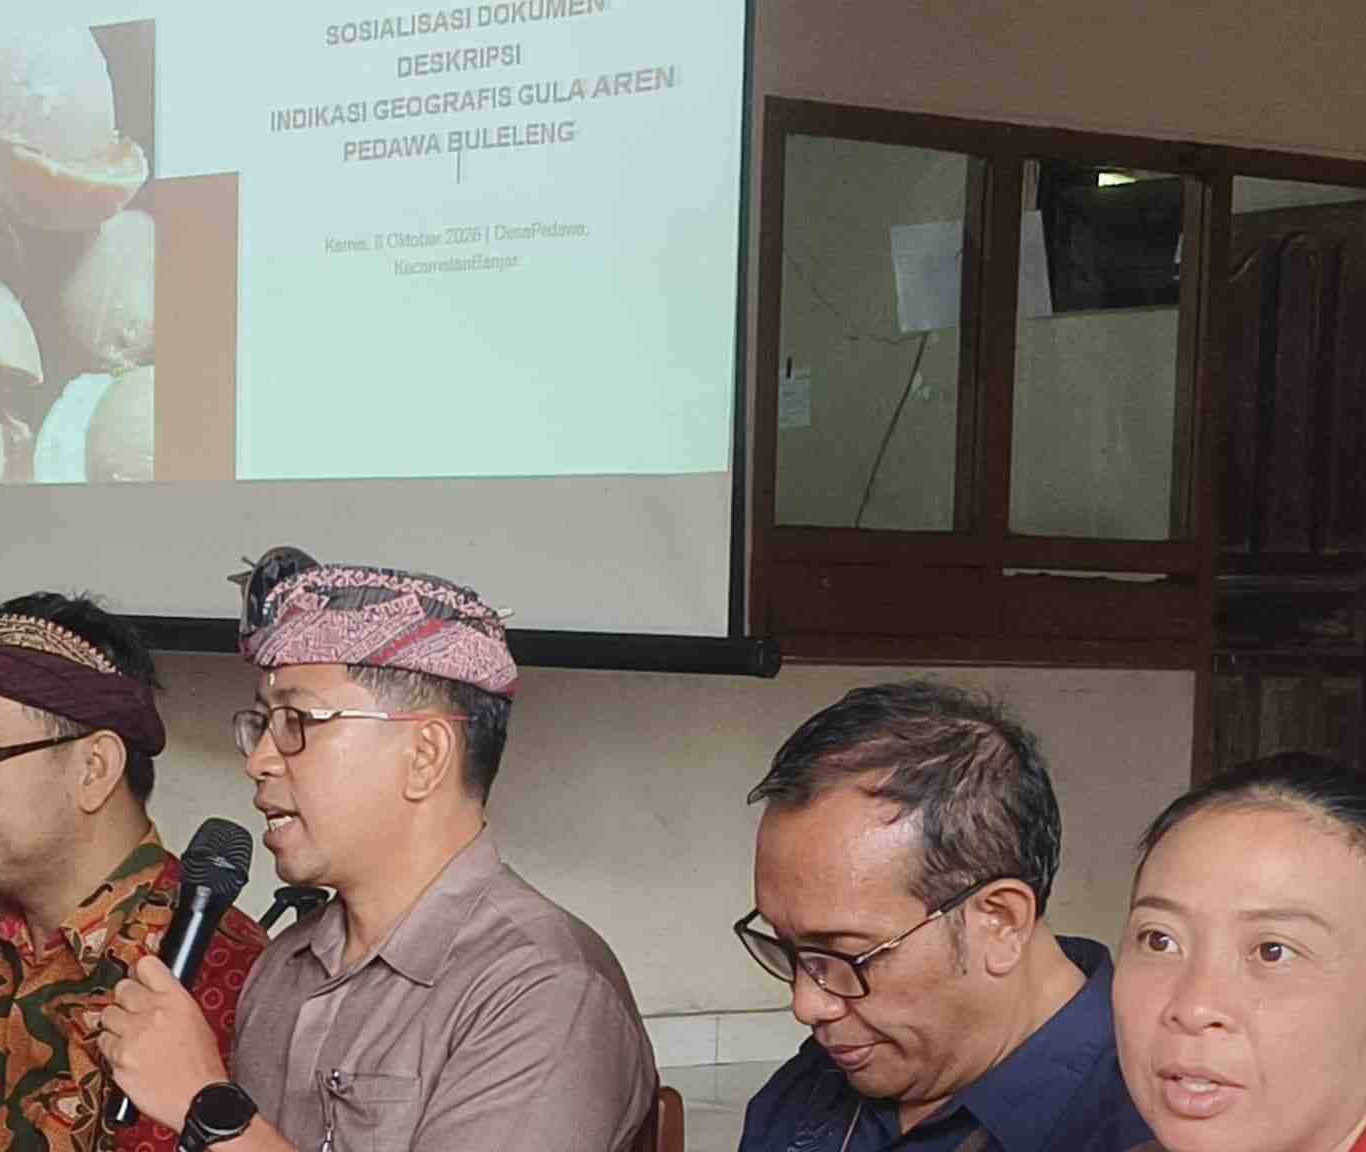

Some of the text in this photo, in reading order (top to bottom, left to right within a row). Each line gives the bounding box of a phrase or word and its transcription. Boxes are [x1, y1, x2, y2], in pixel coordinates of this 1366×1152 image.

[325, 0, 605, 46] SOSIALISASI DOKUMEN
[397, 43, 521, 78] DESKRIPSI
[270, 65, 675, 132] INDIKASI GEOGRAFIS GULA AREN
[343, 121, 575, 162] PEDAWA BULELENG
